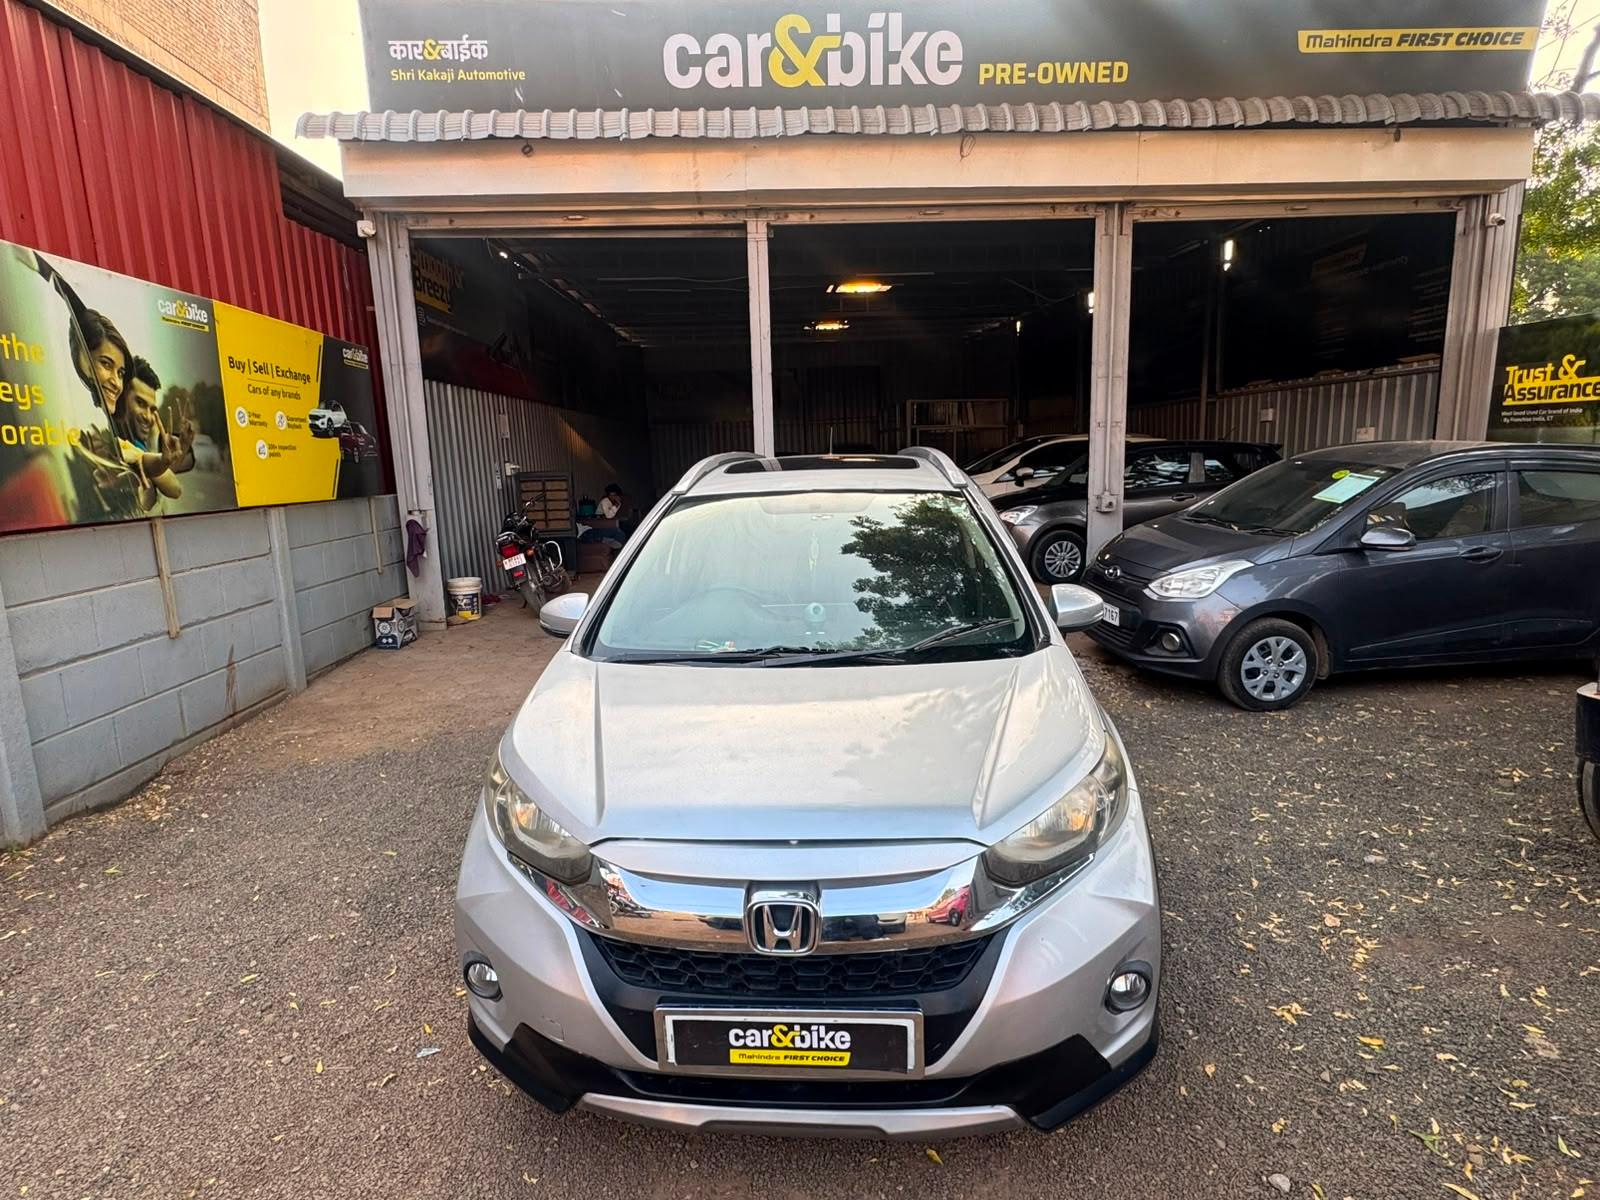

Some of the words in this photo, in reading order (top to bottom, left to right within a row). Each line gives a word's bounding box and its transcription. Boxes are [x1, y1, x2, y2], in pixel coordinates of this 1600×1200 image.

[662, 12, 964, 89] car&bike
[1306, 34, 1393, 48] Mahindra
[1396, 32, 1454, 47] FIRST
[1454, 31, 1525, 47] CHOICE
[390, 69, 415, 81] Shri
[418, 69, 454, 83] Kakaji
[457, 68, 526, 81] Automotive
[978, 61, 1129, 85] PRE-OWNED
[158, 299, 208, 323] car&bike
[0, 332, 44, 364] the
[228, 355, 246, 374] Buy
[252, 361, 270, 376] Sell
[275, 366, 311, 384] Exchange
[1505, 362, 1555, 384] Trust
[1558, 354, 1586, 380] &
[247, 384, 262, 395] Cars
[262, 385, 270, 396] of
[270, 389, 281, 400] any
[281, 388, 302, 400] brands
[1504, 381, 1600, 402] Assurance
[728, 1024, 851, 1050] car&bike
[738, 1053, 781, 1061] Mahindra
